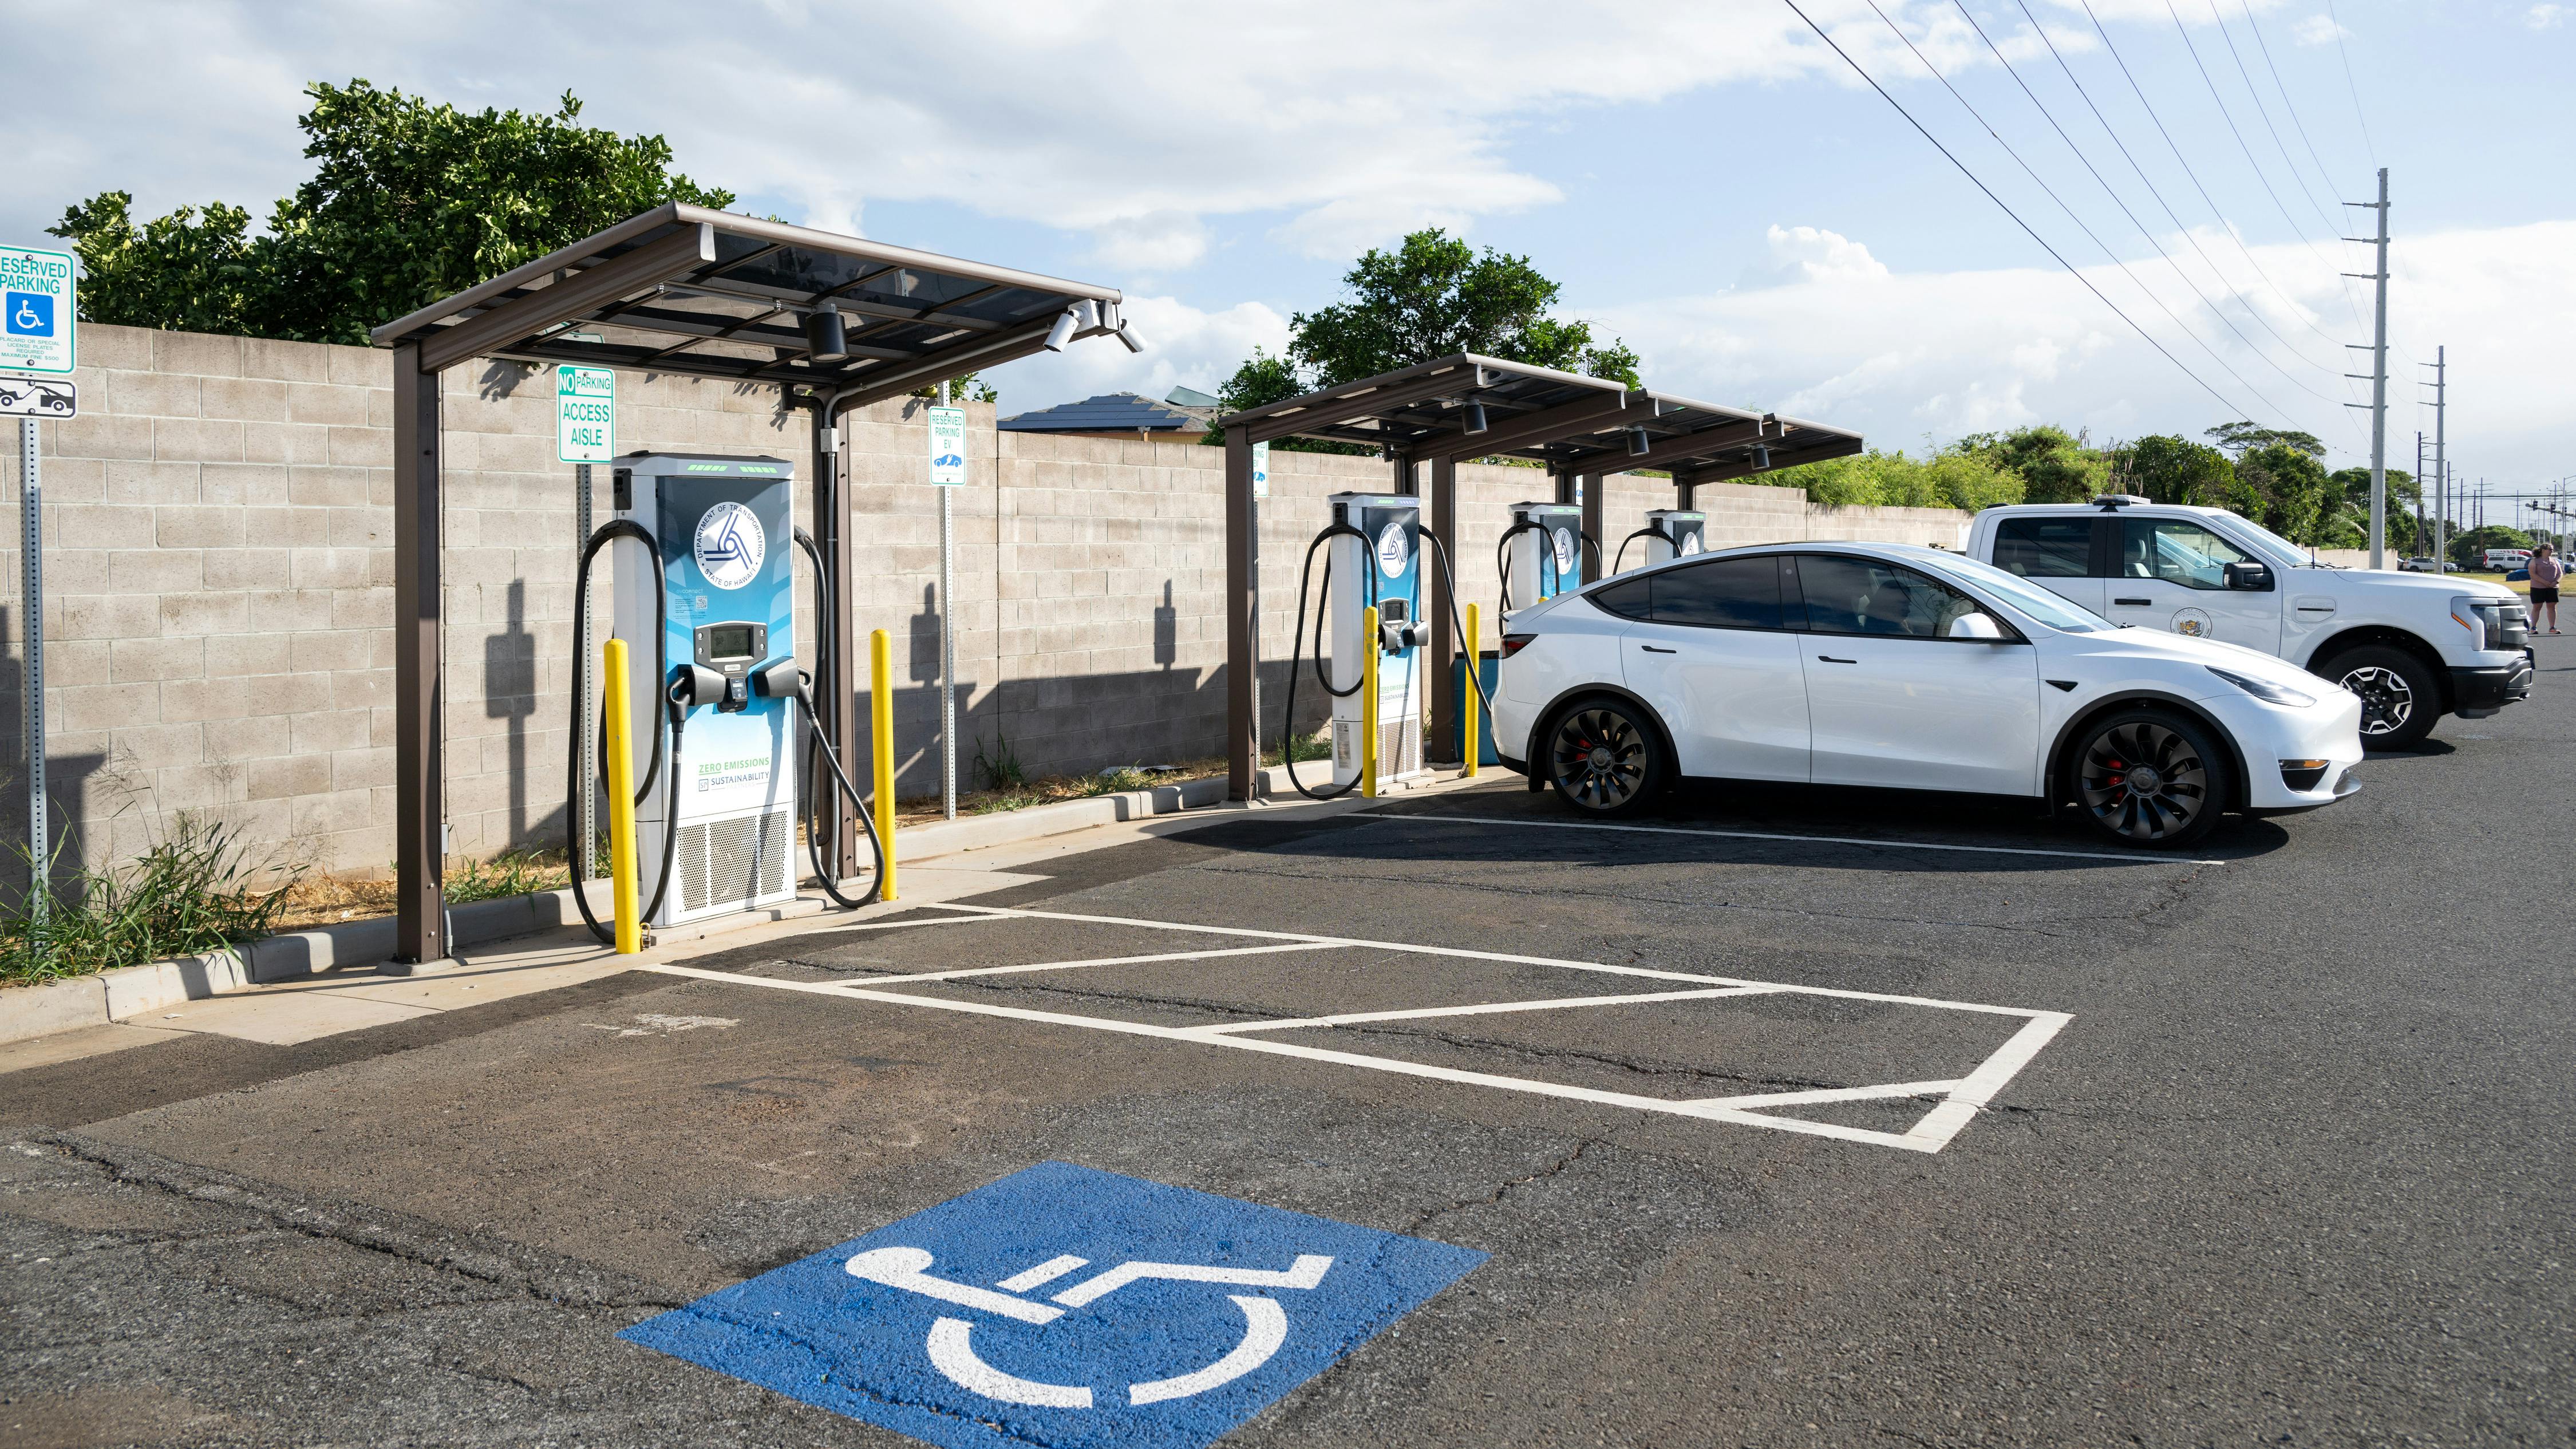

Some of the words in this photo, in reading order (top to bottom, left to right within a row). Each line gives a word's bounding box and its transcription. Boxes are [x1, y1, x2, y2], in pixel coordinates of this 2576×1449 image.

[1, 257, 67, 278] ESERVED
[0, 274, 60, 294] PARKING
[559, 373, 575, 392] NO
[576, 376, 610, 390] PARKING
[563, 403, 610, 423] ACCESS
[932, 414, 962, 426] RESERVED
[571, 428, 603, 446] AISLE
[935, 427, 960, 437] PARKING
[944, 439, 951, 449] EV
[1254, 450, 1264, 458] KING
[696, 510, 716, 559] DEPARTMENT
[718, 504, 726, 512] OF
[730, 504, 763, 558] TRANSPORTATION
[704, 568, 722, 586] STATE
[699, 763, 722, 773] ZERO
[724, 757, 769, 770] EMISSIONS
[711, 771, 769, 785] SUSTAINABILITY
